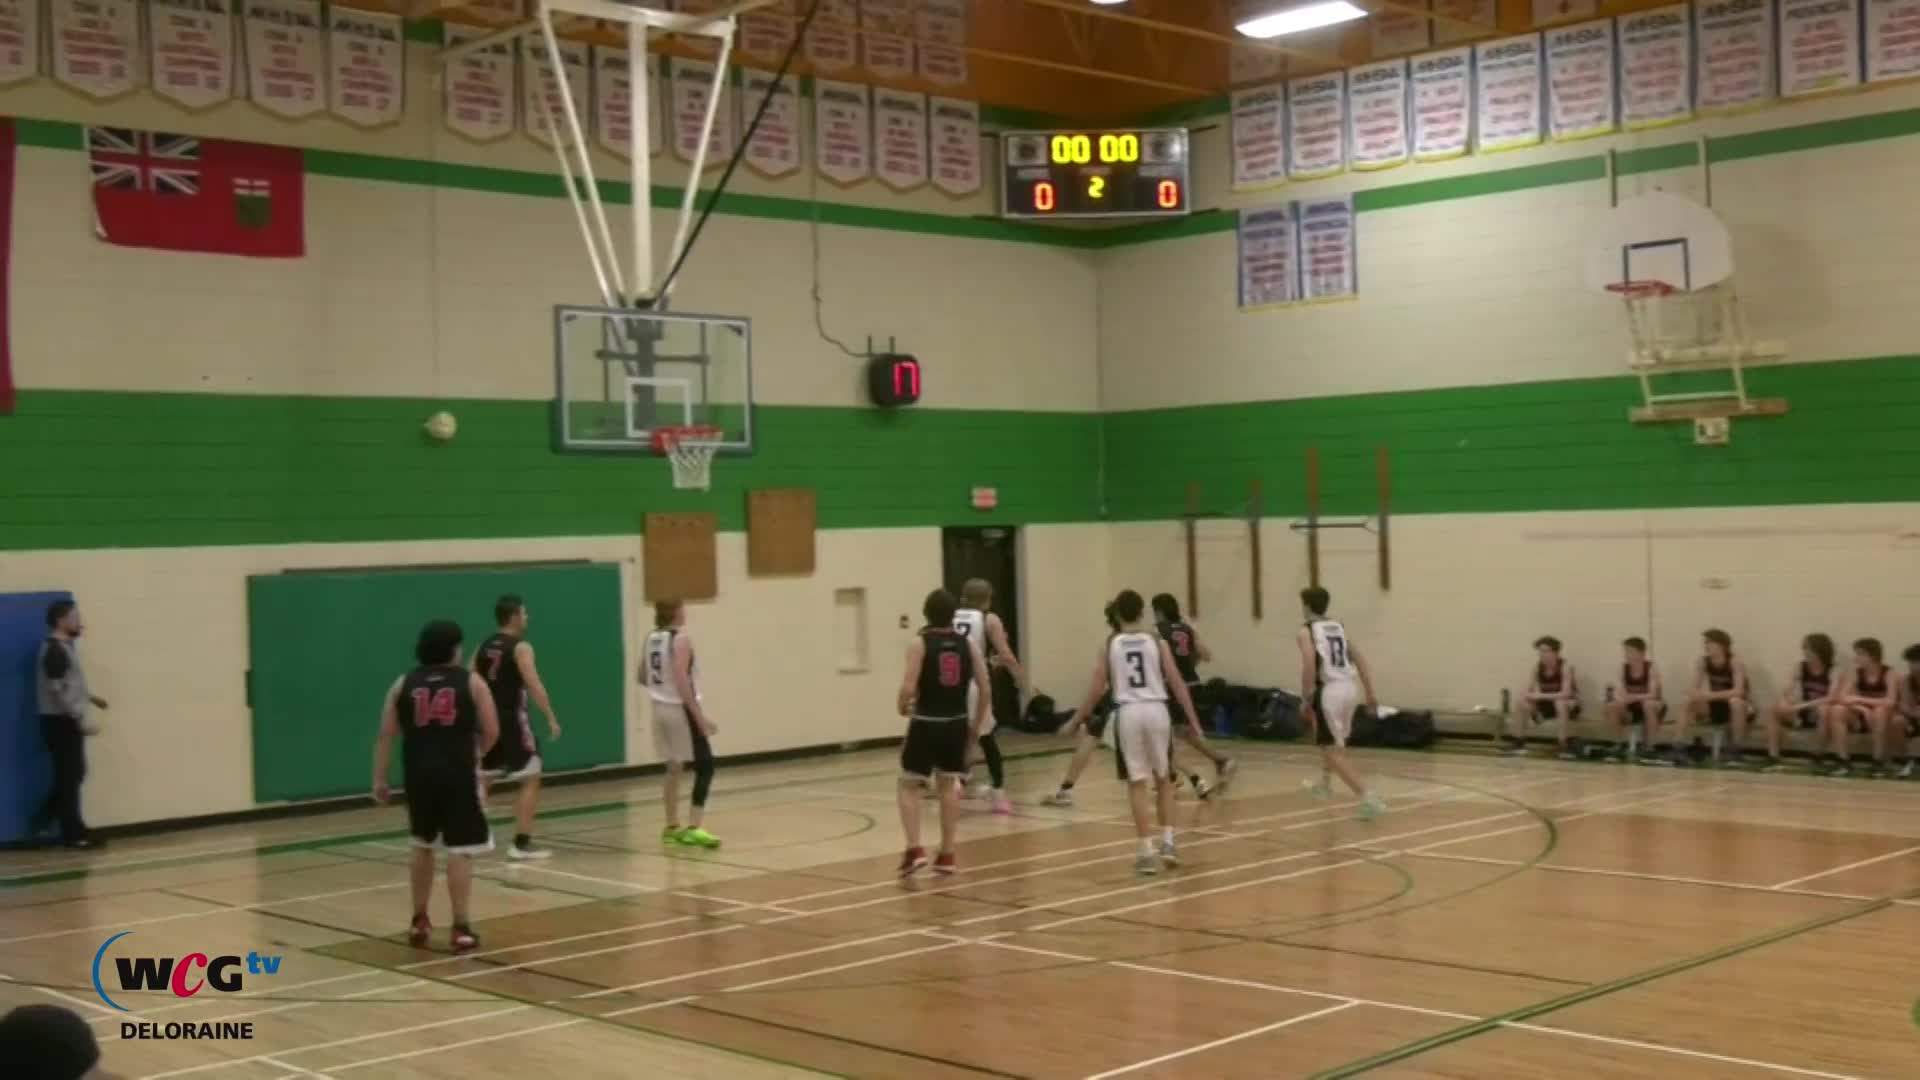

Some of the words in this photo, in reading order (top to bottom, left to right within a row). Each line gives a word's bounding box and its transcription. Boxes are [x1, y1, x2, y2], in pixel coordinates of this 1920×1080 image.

[1052, 135, 1091, 163] 00
[1099, 135, 1138, 162] 00
[1035, 182, 1054, 210] 0
[1088, 175, 1105, 198] 2
[1158, 180, 1178, 208] 0
[487, 649, 504, 680] 7
[1126, 651, 1147, 688] 3
[411, 687, 457, 726] 14
